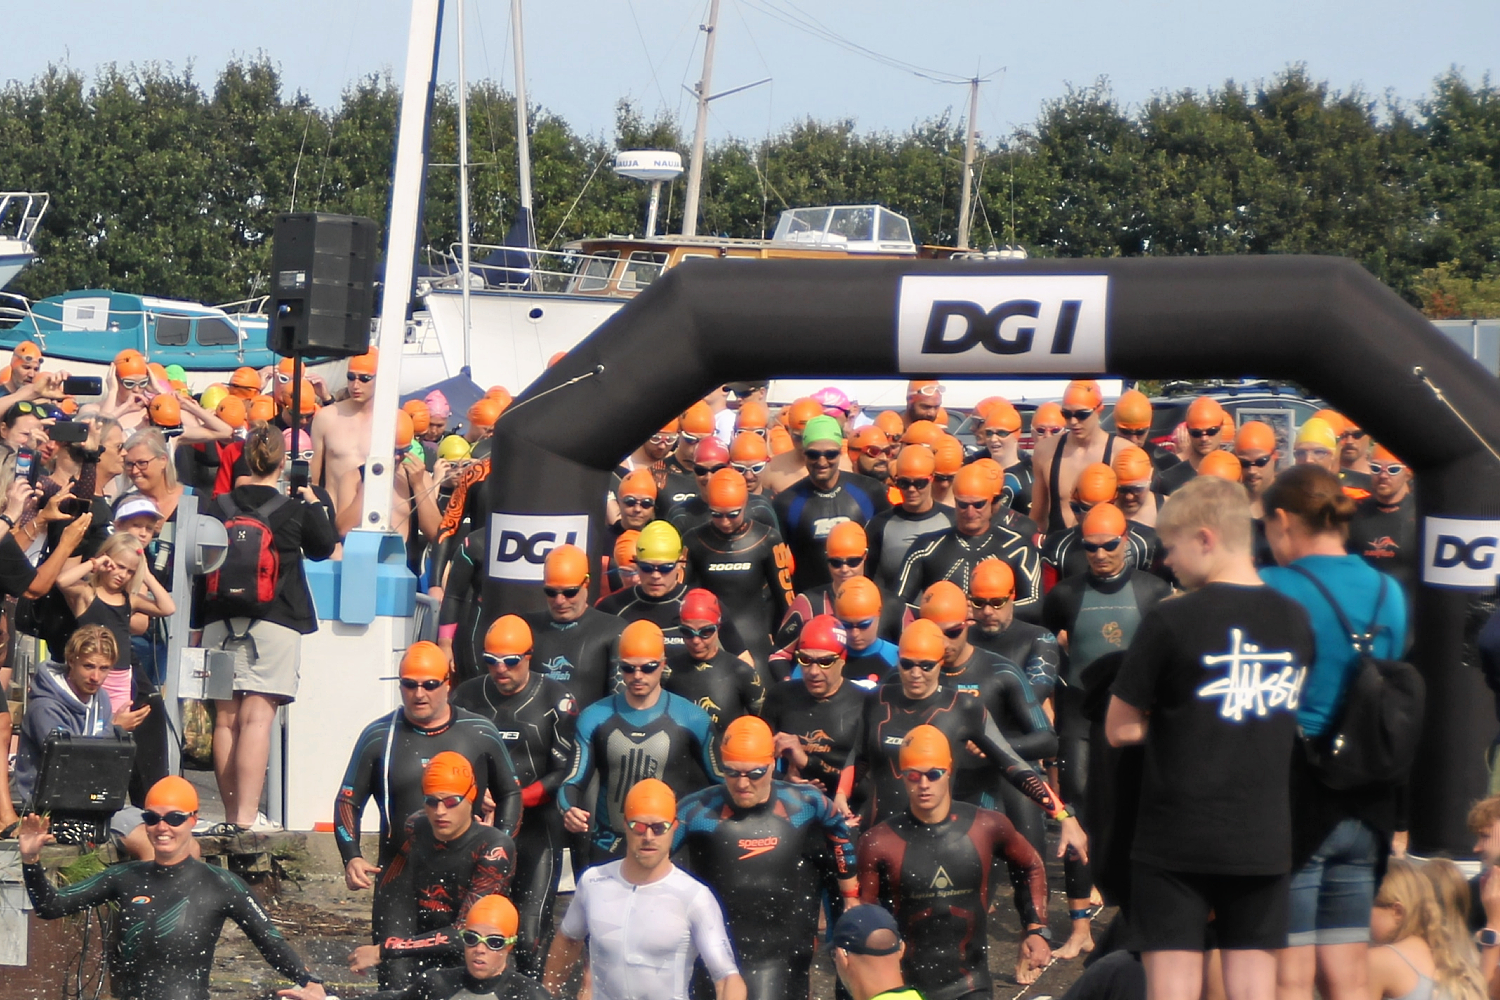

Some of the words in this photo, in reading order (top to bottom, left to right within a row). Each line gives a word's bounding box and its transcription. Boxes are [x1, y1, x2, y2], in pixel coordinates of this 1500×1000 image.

[921, 299, 1083, 355] DGI
[738, 837, 778, 849] speedo
[384, 932, 450, 949] Attack
